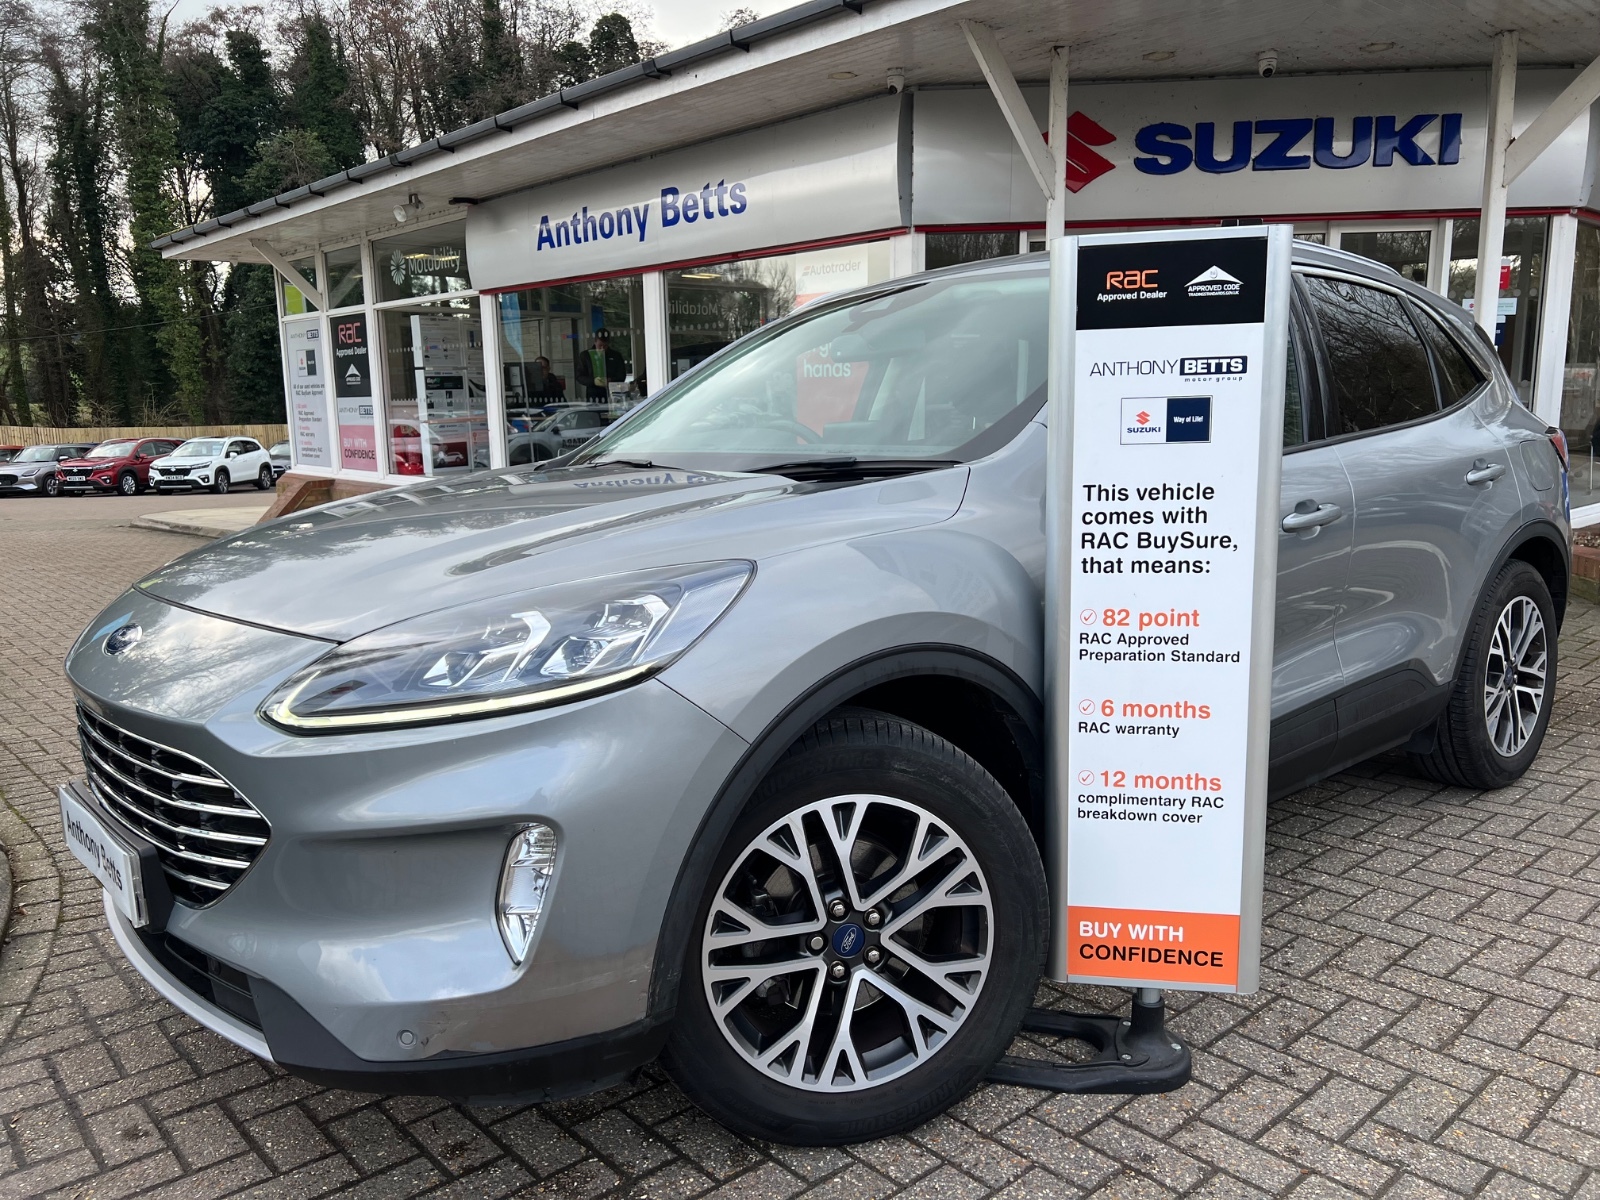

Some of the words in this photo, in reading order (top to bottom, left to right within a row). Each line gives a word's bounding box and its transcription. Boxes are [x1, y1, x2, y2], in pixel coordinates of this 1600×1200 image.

[1134, 113, 1463, 175] SUZUKI
[536, 201, 650, 251] Anthony
[661, 178, 748, 228] Betts
[408, 246, 461, 275] Motability
[810, 260, 861, 277] Autotrader
[1097, 291, 1138, 302] Approved
[1140, 290, 1167, 300] Dealer
[1187, 284, 1222, 293] APPROVED
[1223, 283, 1241, 291] CODE
[336, 347, 354, 358] Approved
[354, 346, 367, 355] Dealer
[1089, 359, 1179, 377] ANTHONY
[1184, 358, 1244, 374] BETTS
[1173, 415, 1185, 424] Way
[1127, 426, 1161, 434] SUZUKI
[343, 438, 353, 448] BUY
[354, 438, 367, 448] WITH
[344, 448, 376, 460] CONFIDENCE
[1082, 483, 1129, 502] This
[1136, 482, 1215, 501] vehicle
[1081, 510, 1154, 525] comes
[1162, 506, 1208, 524] with
[1081, 531, 1129, 549] RAC
[1137, 531, 1238, 553] BuySure,
[1081, 556, 1123, 574] that
[1131, 559, 1211, 574] means:
[1102, 608, 1130, 627] 82
[1138, 608, 1200, 632] point
[1079, 632, 1112, 645] RAC
[1116, 632, 1189, 648] Approved
[1079, 649, 1165, 664] Preparation
[1171, 650, 1240, 663] Standard
[1101, 699, 1115, 717] 6
[1122, 700, 1211, 719] months
[1078, 721, 1111, 734] RAC
[1115, 724, 1180, 738] warranty
[1100, 770, 1126, 788] 12
[1134, 773, 1222, 791] months
[1077, 793, 1187, 810] complimentary
[1191, 796, 1224, 809] RAC
[1077, 807, 1157, 822] breakdown
[1162, 812, 1203, 823] cover
[66, 810, 101, 868] Anthony
[100, 843, 123, 891] Betts
[1079, 920, 1122, 939] BUY
[1128, 923, 1184, 942] WITH
[1079, 943, 1224, 967] CONFIDENCE
